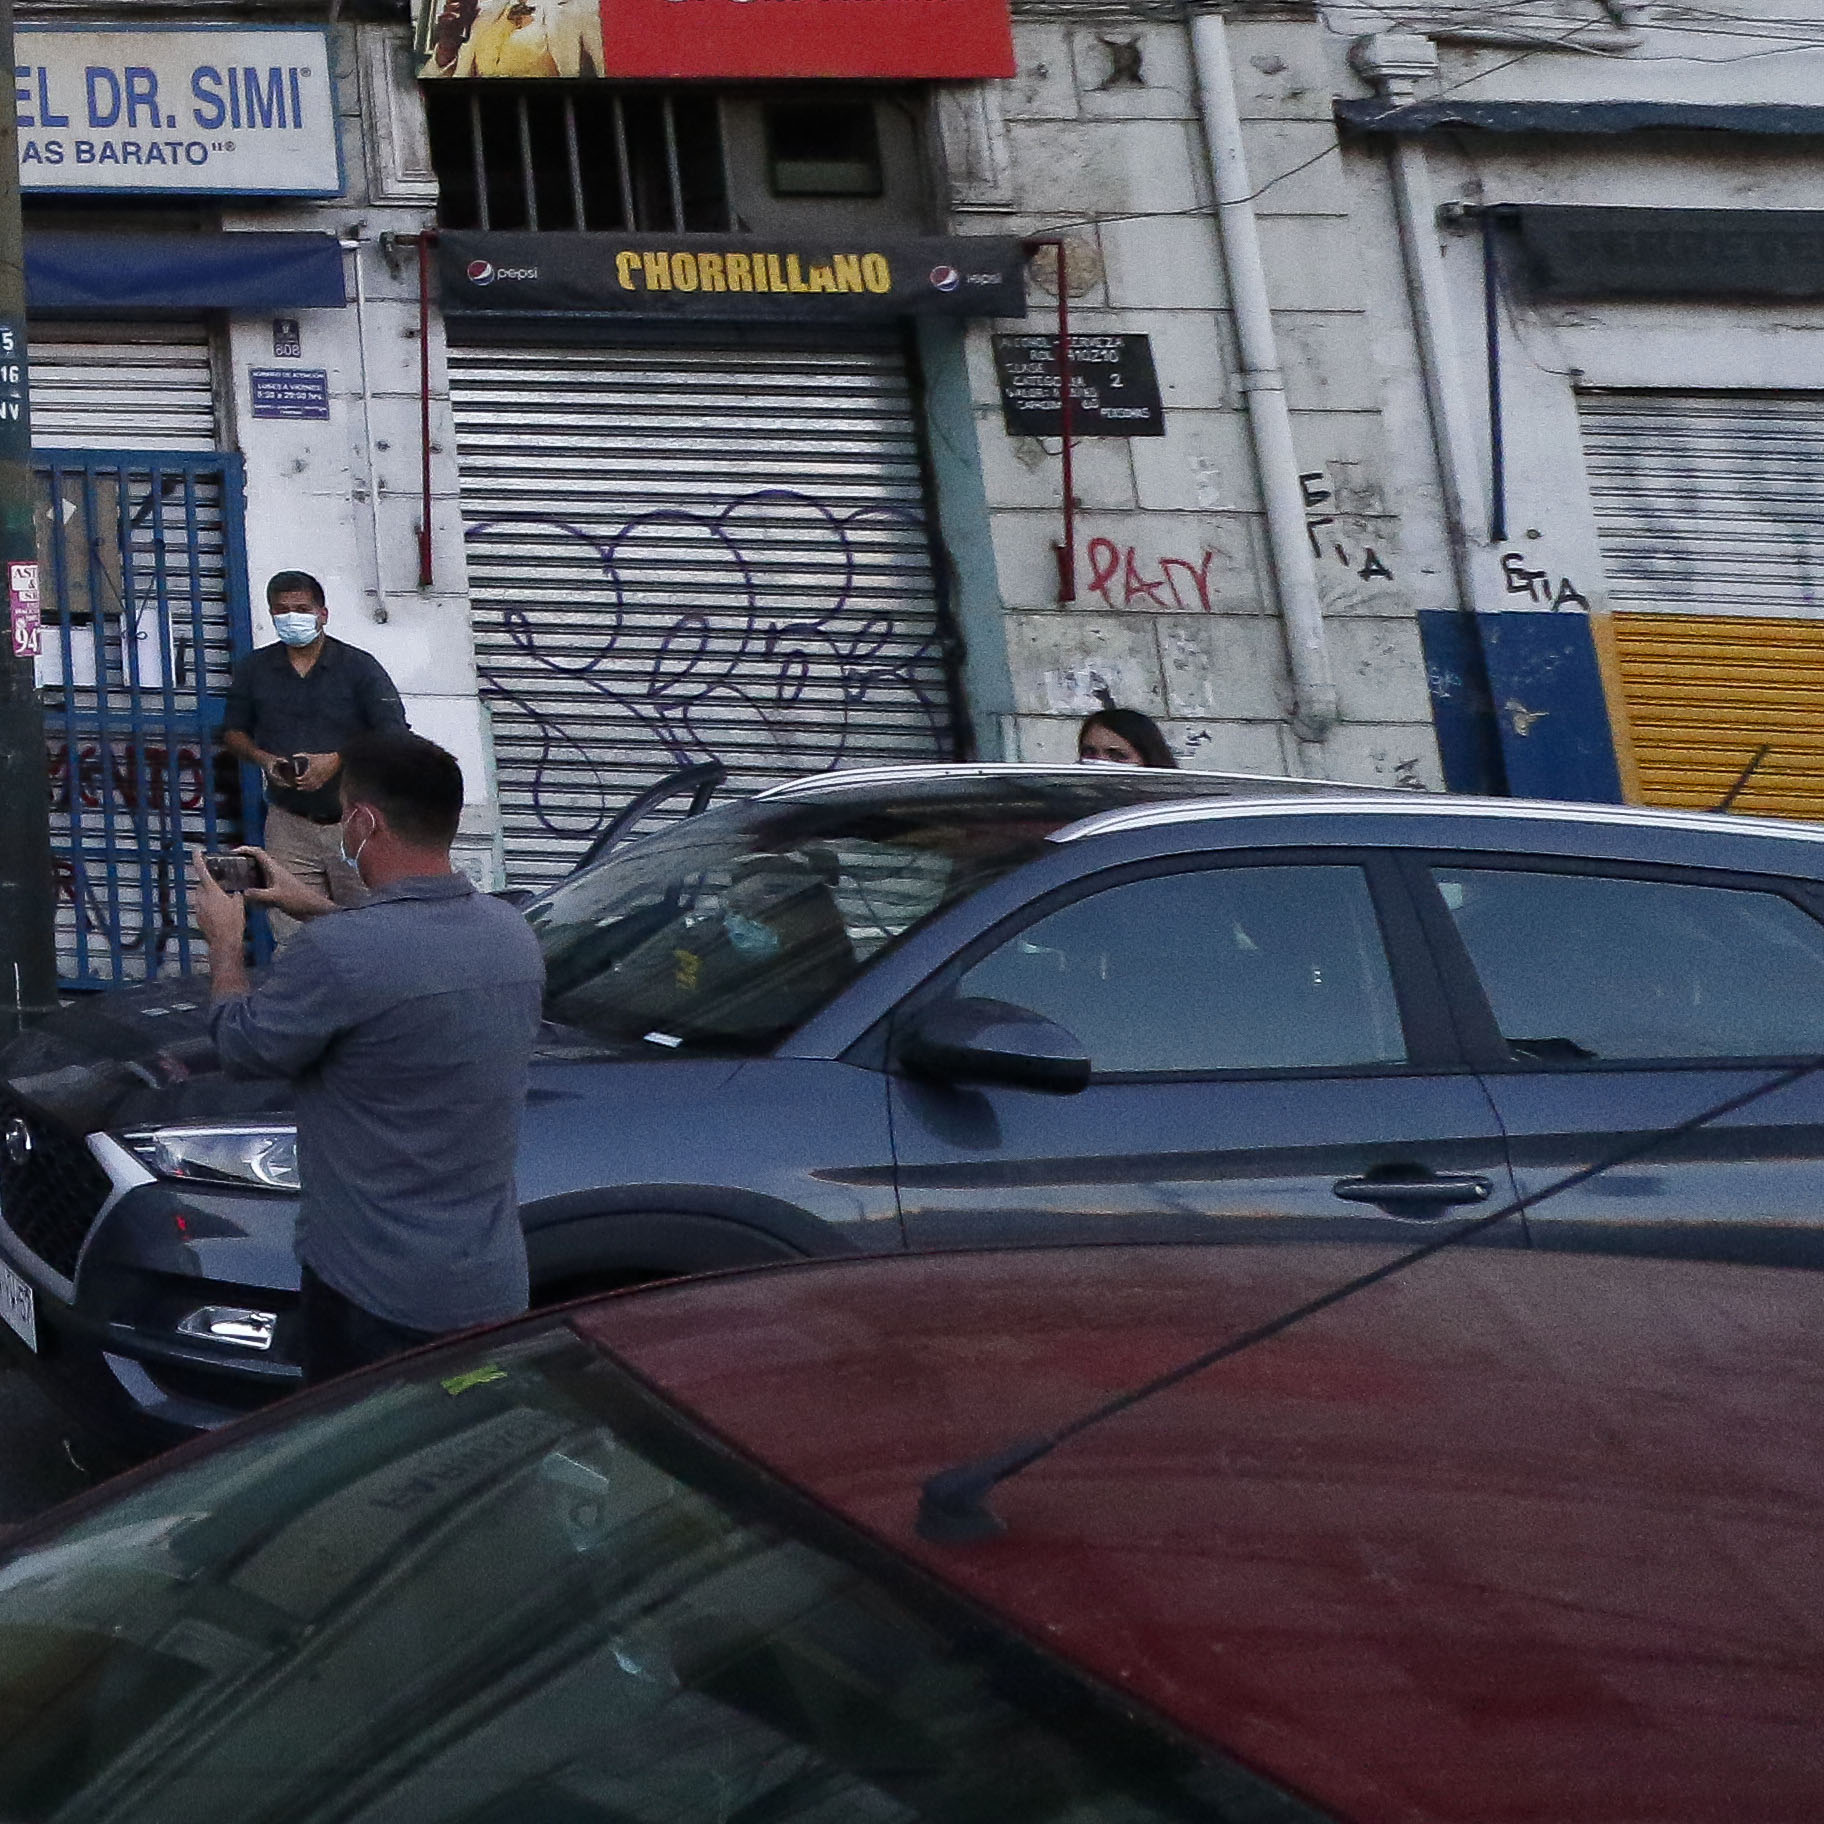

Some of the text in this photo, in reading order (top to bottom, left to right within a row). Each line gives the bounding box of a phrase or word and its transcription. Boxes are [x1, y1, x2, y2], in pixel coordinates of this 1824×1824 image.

[14, 66, 70, 128] EL
[85, 65, 177, 129] DR.
[20, 141, 64, 165] AS
[496, 266, 539, 281] pepsi
[615, 249, 892, 295] CHORRILLANO
[1109, 373, 1124, 388] 2
